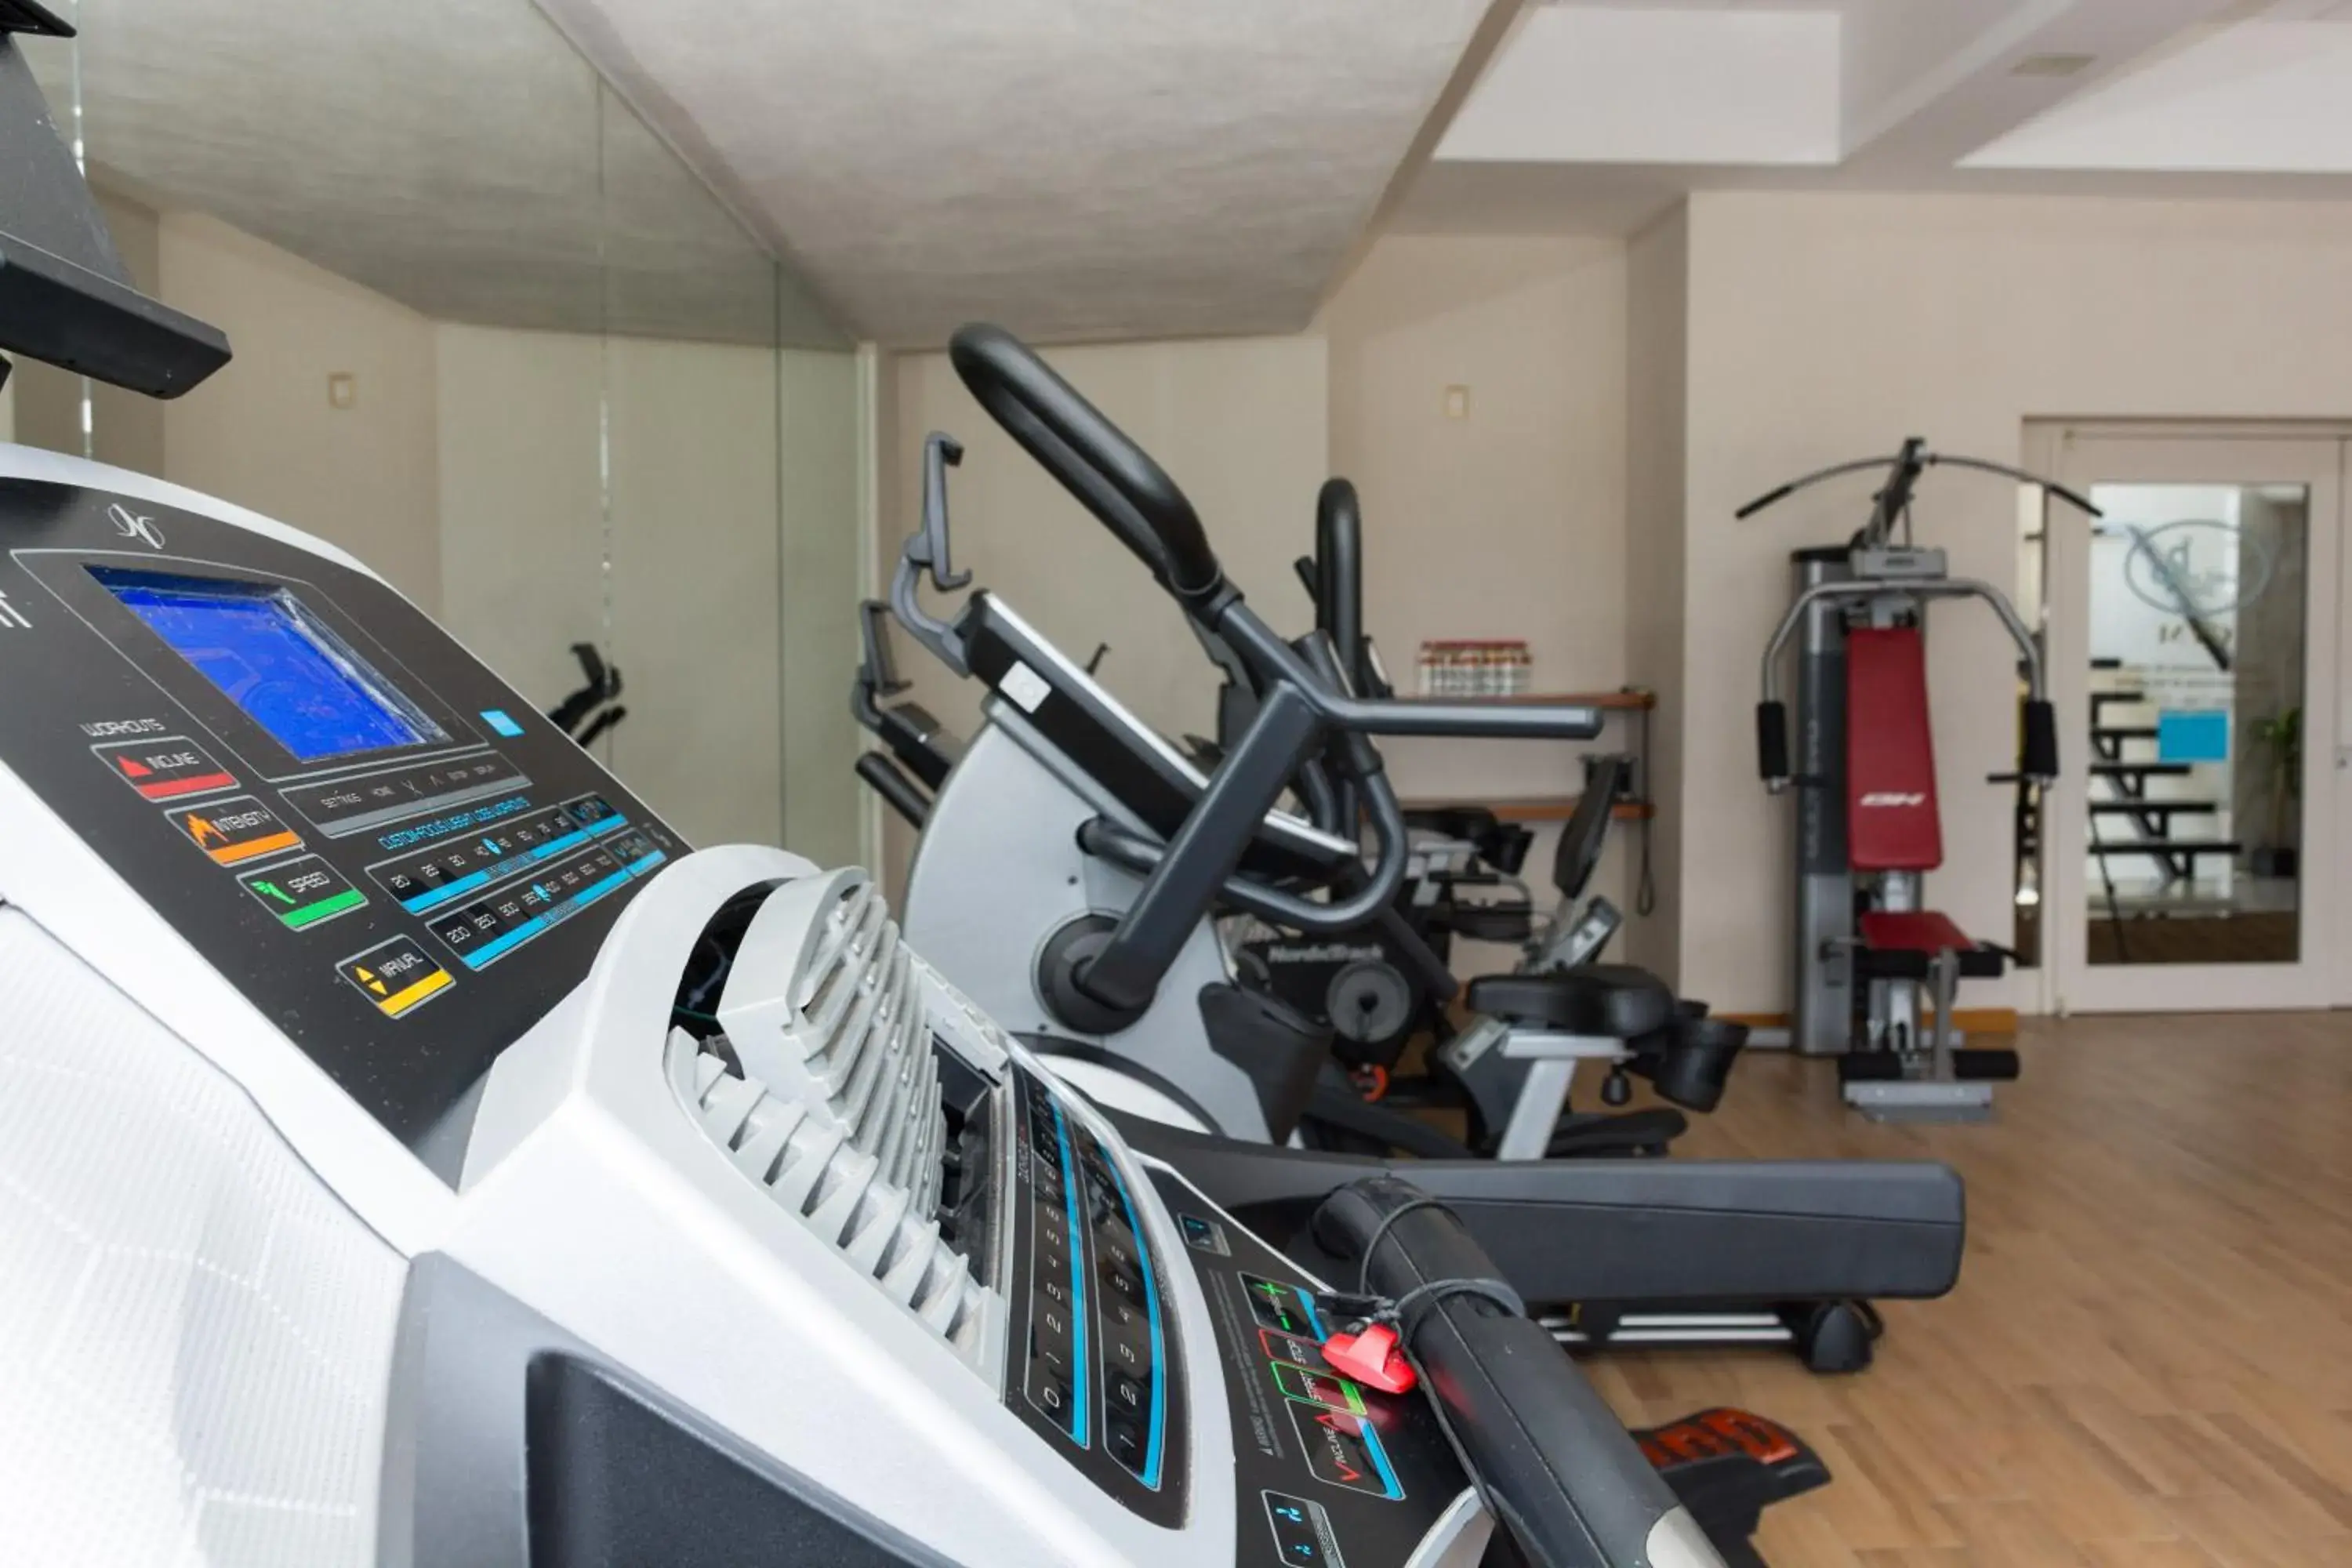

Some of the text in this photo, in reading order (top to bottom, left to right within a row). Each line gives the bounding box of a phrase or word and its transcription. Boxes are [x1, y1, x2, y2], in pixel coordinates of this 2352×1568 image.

[78, 717, 167, 737] WORKOUTS
[145, 752, 200, 769] INCLINE
[212, 809, 272, 833] INTENSITY
[288, 871, 331, 893] SPEED
[390, 874, 411, 889] 20
[446, 926, 471, 943] 200
[474, 913, 496, 929] 250
[379, 952, 424, 978] MANUAL
[1047, 1283, 1061, 1301] 3
[1046, 1313, 1061, 1334] 2
[1045, 1352, 1061, 1364] 1
[1120, 1343, 1134, 1363] 3
[1044, 1387, 1060, 1408] 0
[1120, 1384, 1136, 1405] 2
[1120, 1434, 1135, 1448] 1
[1323, 1426, 1347, 1464] INCLINE
